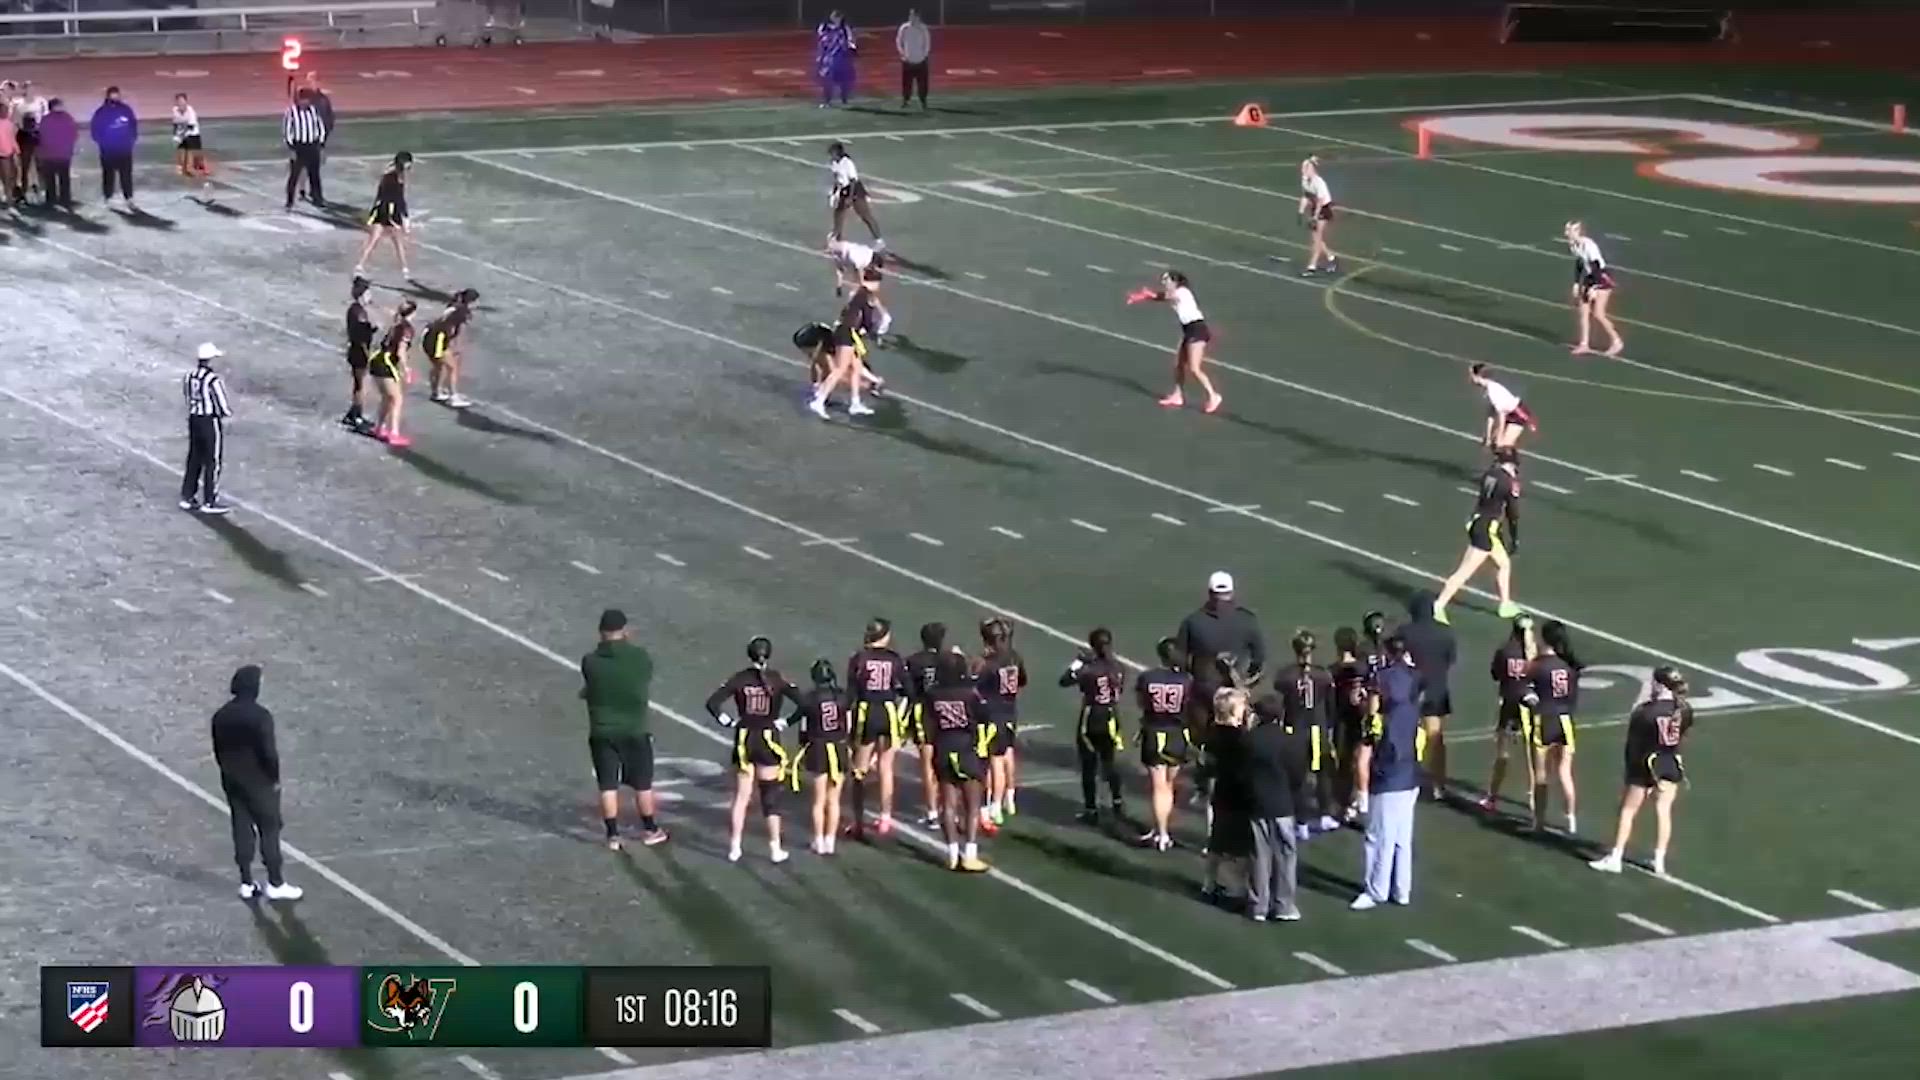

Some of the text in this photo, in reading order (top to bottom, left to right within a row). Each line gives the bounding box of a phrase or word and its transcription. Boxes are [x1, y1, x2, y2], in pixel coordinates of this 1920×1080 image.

[282, 39, 302, 70] 2
[866, 659, 893, 691] 31
[1147, 682, 1185, 714] 33
[819, 700, 840, 732] 2
